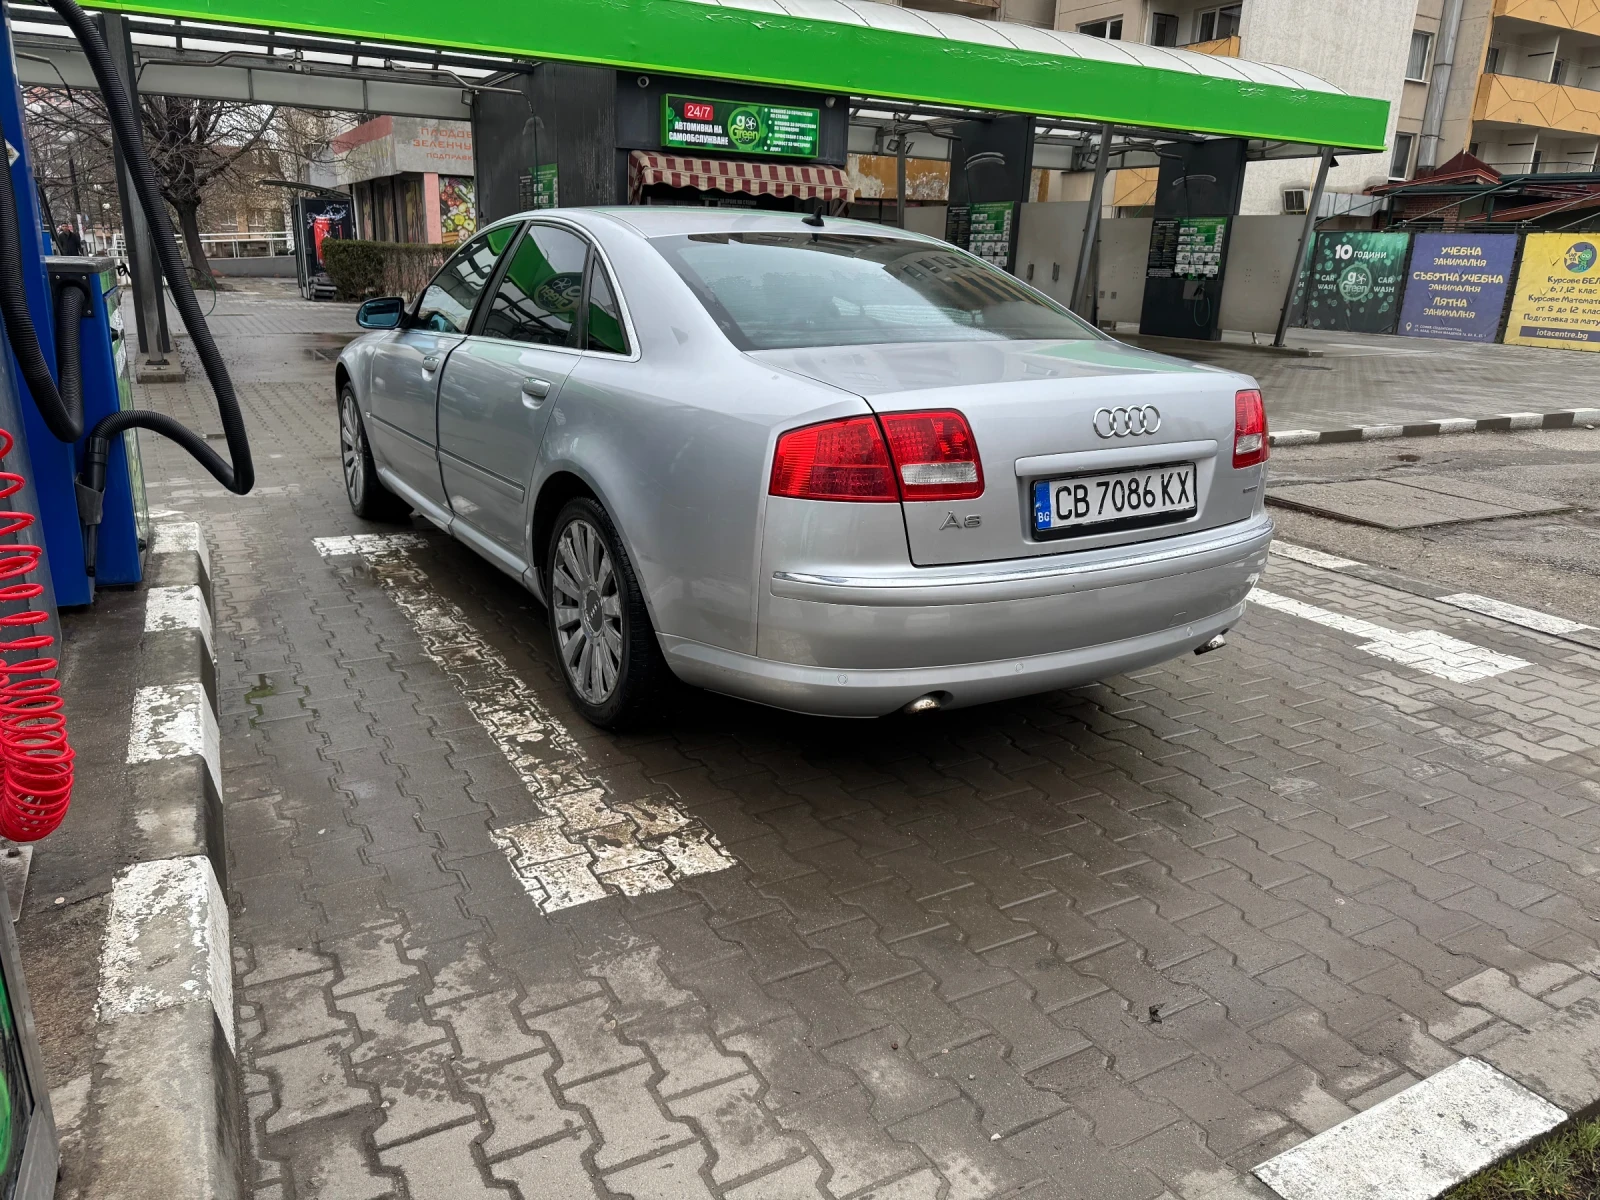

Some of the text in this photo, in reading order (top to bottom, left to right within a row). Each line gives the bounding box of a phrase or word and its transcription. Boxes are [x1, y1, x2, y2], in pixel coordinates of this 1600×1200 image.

[687, 105, 711, 118] 24/7
[674, 121, 723, 134] АВТОМИВКА НА
[731, 125, 759, 140] Green
[668, 131, 729, 146] САМООБСЛУЖВАНЕ
[1335, 244, 1387, 260] 10 ГОДИНИ
[1441, 246, 1482, 256] УЧЕБНА
[1433, 257, 1487, 267] ЗАНИМАЛНЯ
[1377, 276, 1393, 284] CAR
[1413, 271, 1504, 284] СЪБОТНА УЧЕБНА
[1547, 275, 1580, 285] Курсове
[1373, 285, 1395, 293] WASH
[1428, 283, 1482, 293] ЗАНИМАЛНЯ
[1433, 297, 1468, 308] ЛЯТНА
[1528, 294, 1560, 303] Курсове
[1423, 307, 1476, 319] ЗАНИМАЛНЯ
[1523, 313, 1568, 323] Подготовка
[1536, 328, 1588, 341] iotacentre.bg
[1055, 470, 1190, 520] CB 7086 KX
[939, 510, 982, 530] A8
[1037, 511, 1050, 522] BG
